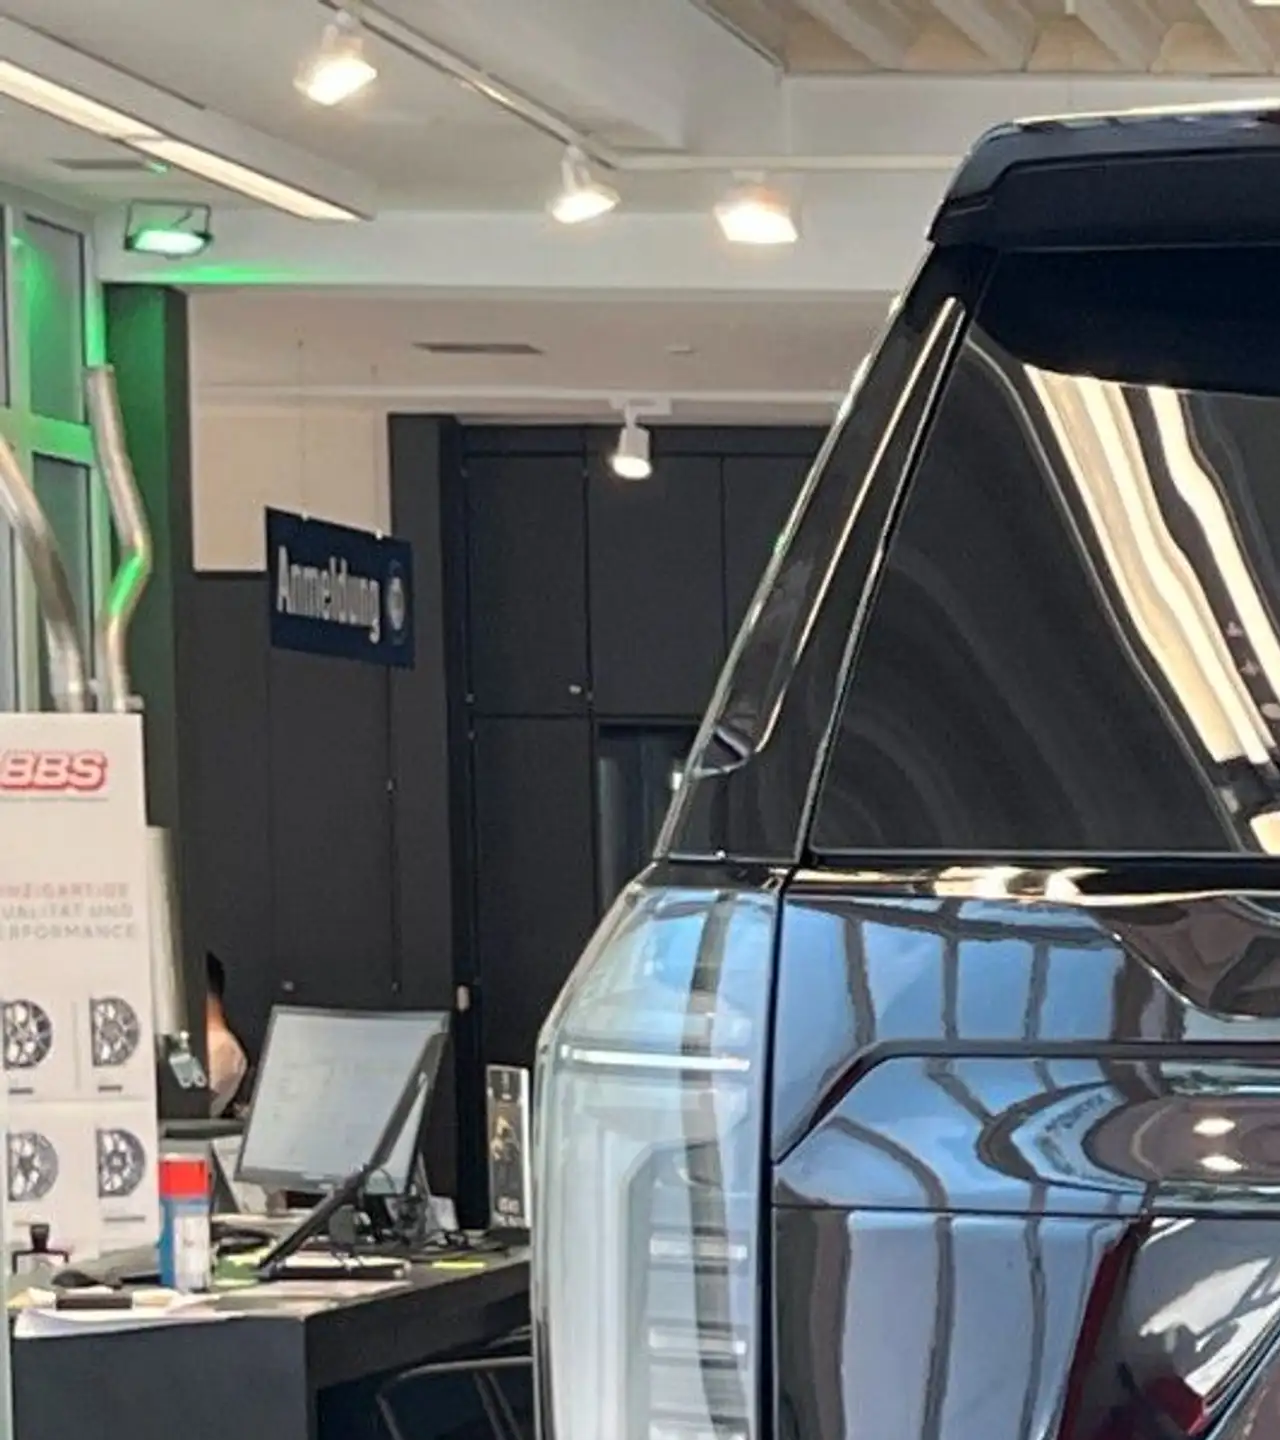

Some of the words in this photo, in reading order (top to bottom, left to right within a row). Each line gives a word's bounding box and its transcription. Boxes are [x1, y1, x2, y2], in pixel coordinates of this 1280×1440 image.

[276, 545, 380, 644] Anmeldung
[0, 750, 108, 792] BBS
[0, 923, 137, 940] RFORMANCE
